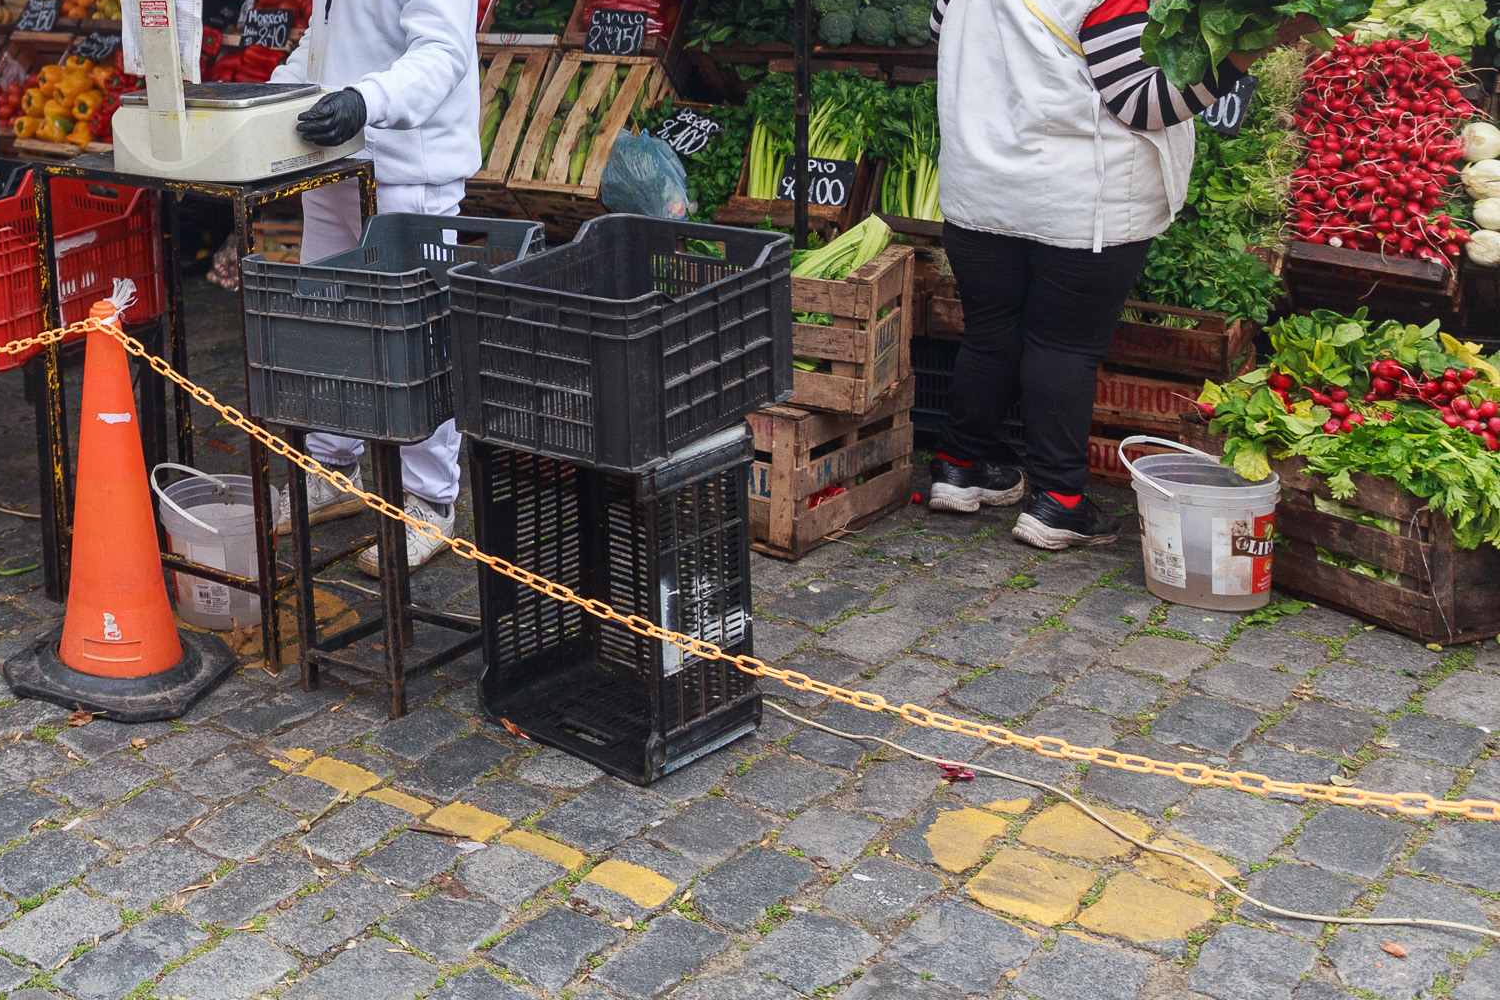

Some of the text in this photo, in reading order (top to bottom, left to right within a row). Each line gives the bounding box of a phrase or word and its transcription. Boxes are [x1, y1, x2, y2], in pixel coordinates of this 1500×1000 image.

[592, 10, 645, 25] CHOCLO
[256, 24, 287, 48] 240
[668, 125, 708, 155] 100
[807, 176, 845, 206] 100
